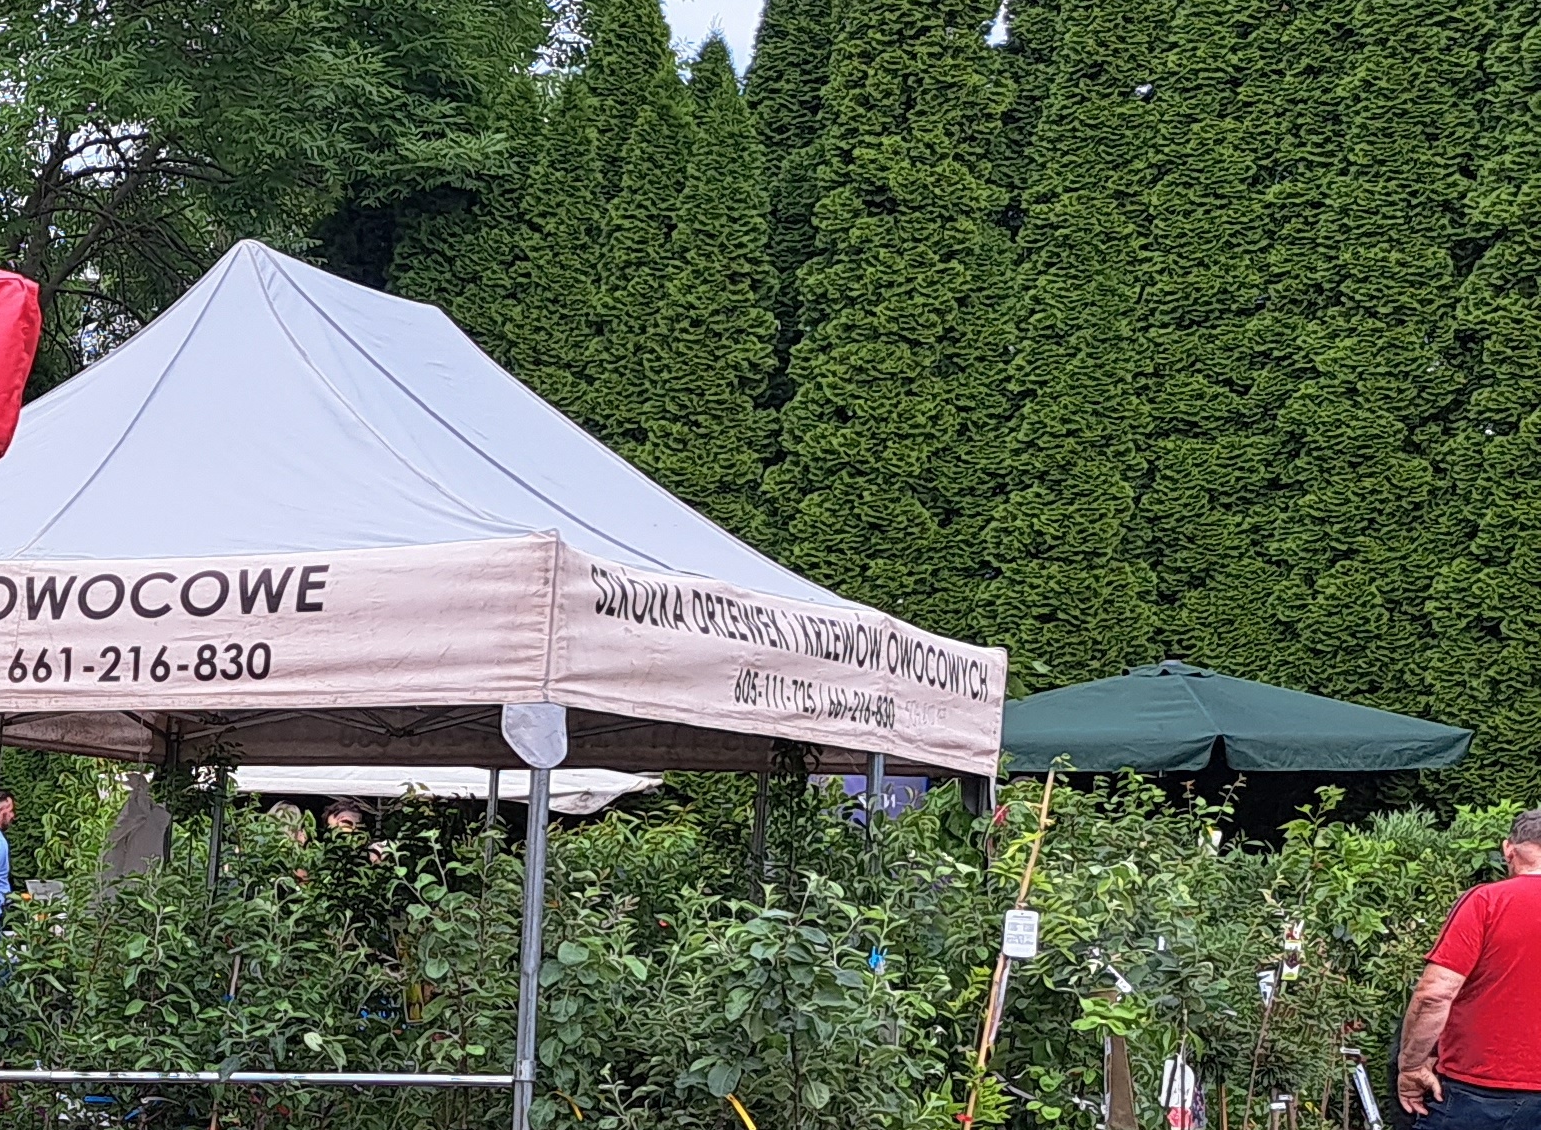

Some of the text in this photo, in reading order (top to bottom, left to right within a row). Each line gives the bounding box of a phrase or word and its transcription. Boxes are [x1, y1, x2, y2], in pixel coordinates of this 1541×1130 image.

[7, 641, 272, 684] 661-216-830
[692, 588, 790, 651] DRZEWEK
[793, 611, 884, 671] KRZEWÓW
[886, 631, 989, 703] OWOCOWYCH
[733, 667, 817, 716] 605-111-725
[826, 685, 896, 731] 661-216-830
